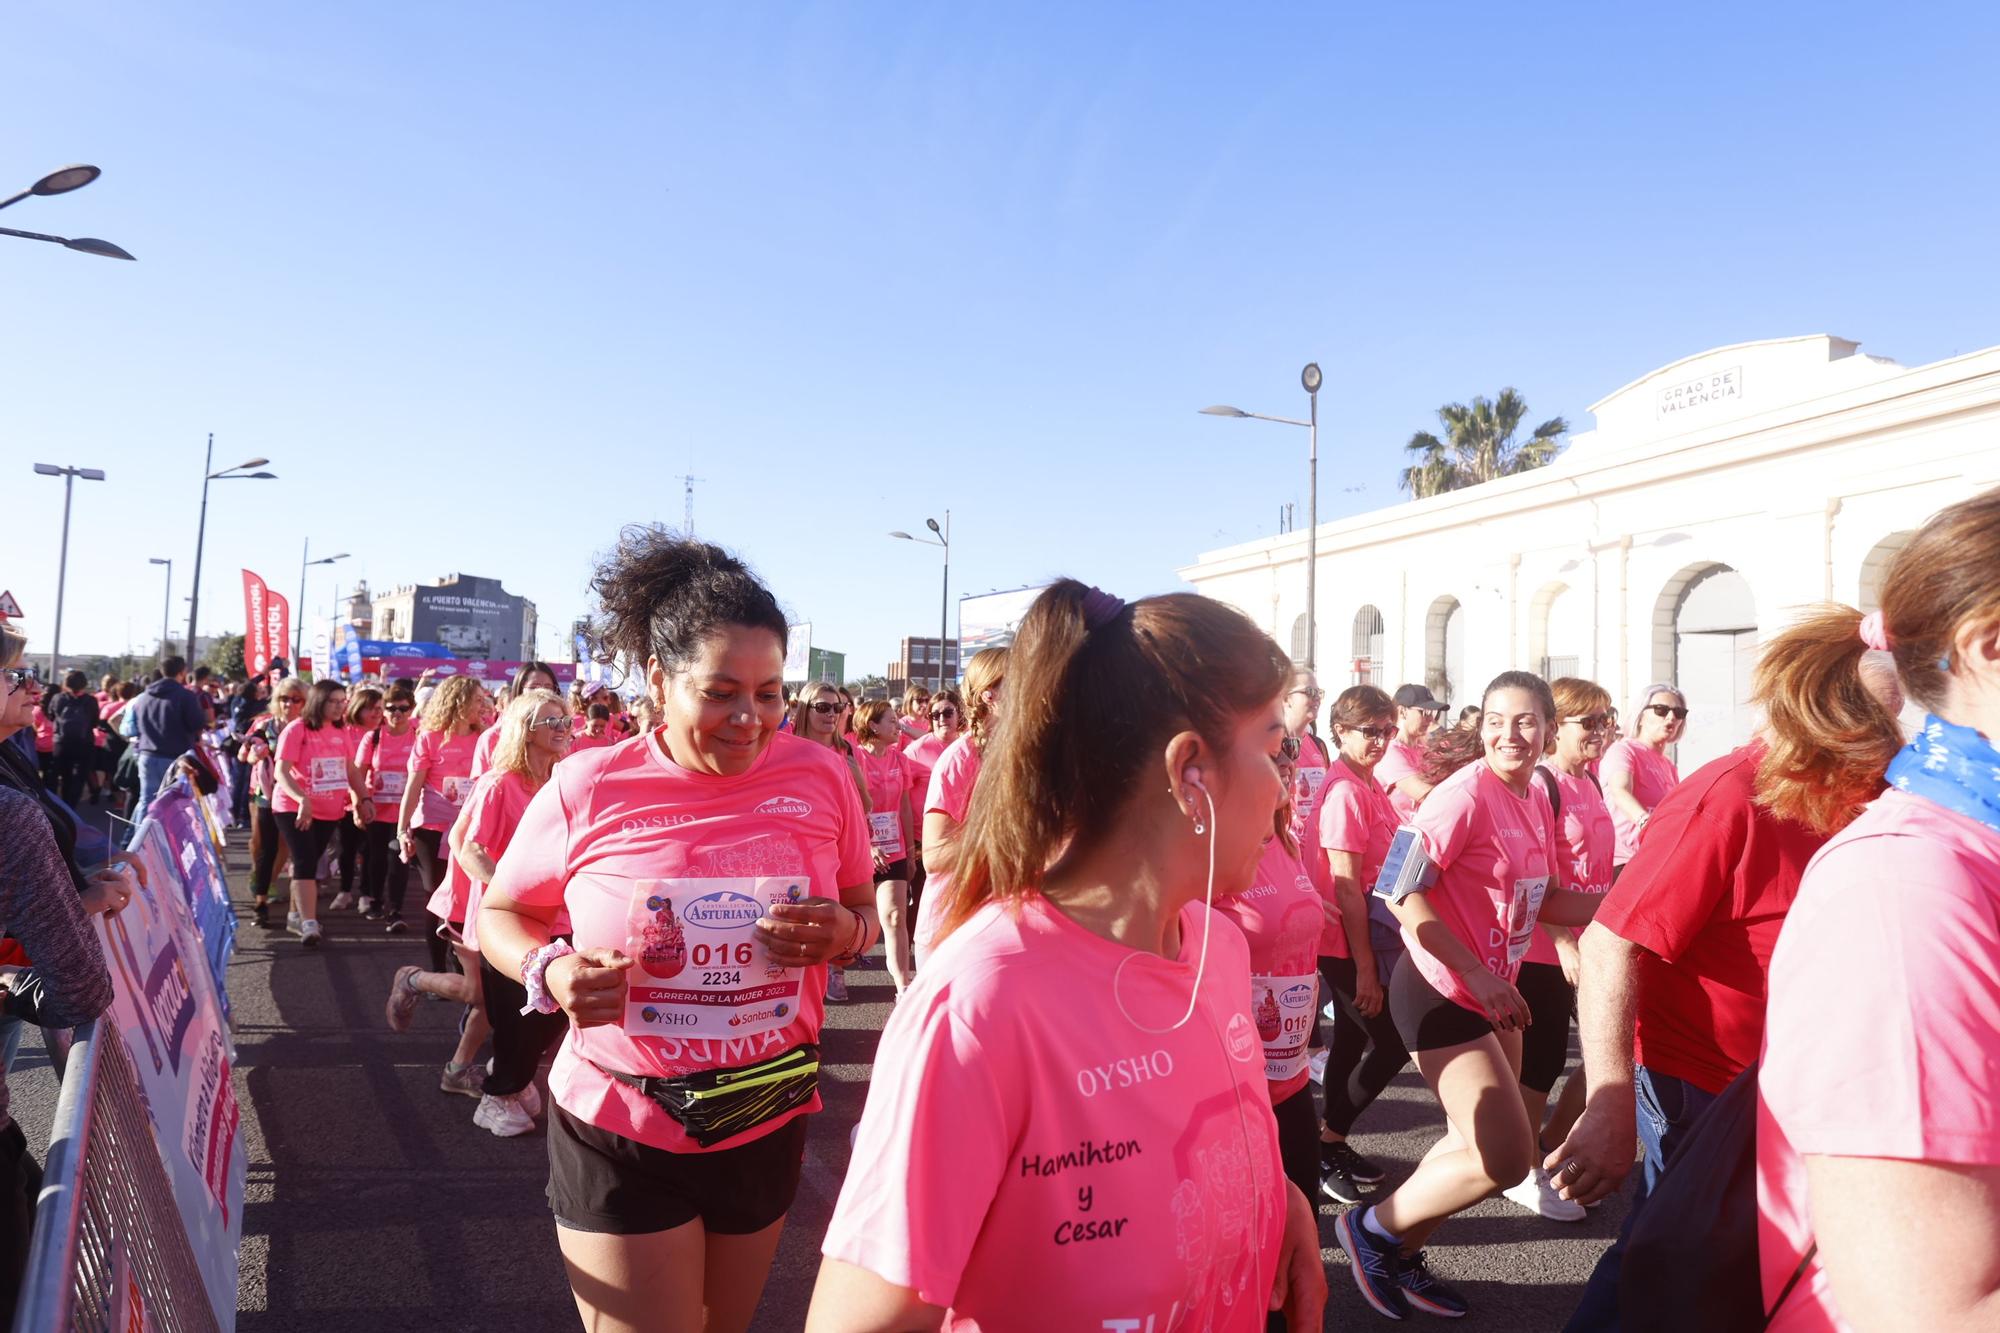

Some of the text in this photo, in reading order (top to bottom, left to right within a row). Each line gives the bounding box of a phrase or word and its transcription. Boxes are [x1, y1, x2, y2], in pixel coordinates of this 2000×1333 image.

[1664, 373, 1733, 401] GRAO DE
[1661, 385, 1736, 414] VALENCIA
[431, 596, 460, 605] PUERTO
[689, 905, 759, 921] ASTURIANA
[692, 942, 753, 966] 016
[702, 971, 741, 986] 2234
[649, 986, 786, 1003] CARRERA DE LA MUJER 2023
[655, 1012, 698, 1026] YSHO
[1284, 1015, 1308, 1032] 016
[1076, 1049, 1173, 1097] OYSHO
[1021, 1139, 1142, 1177] Hamihton
[1078, 1185, 1093, 1212] y
[1053, 1217, 1129, 1246] Cesar
